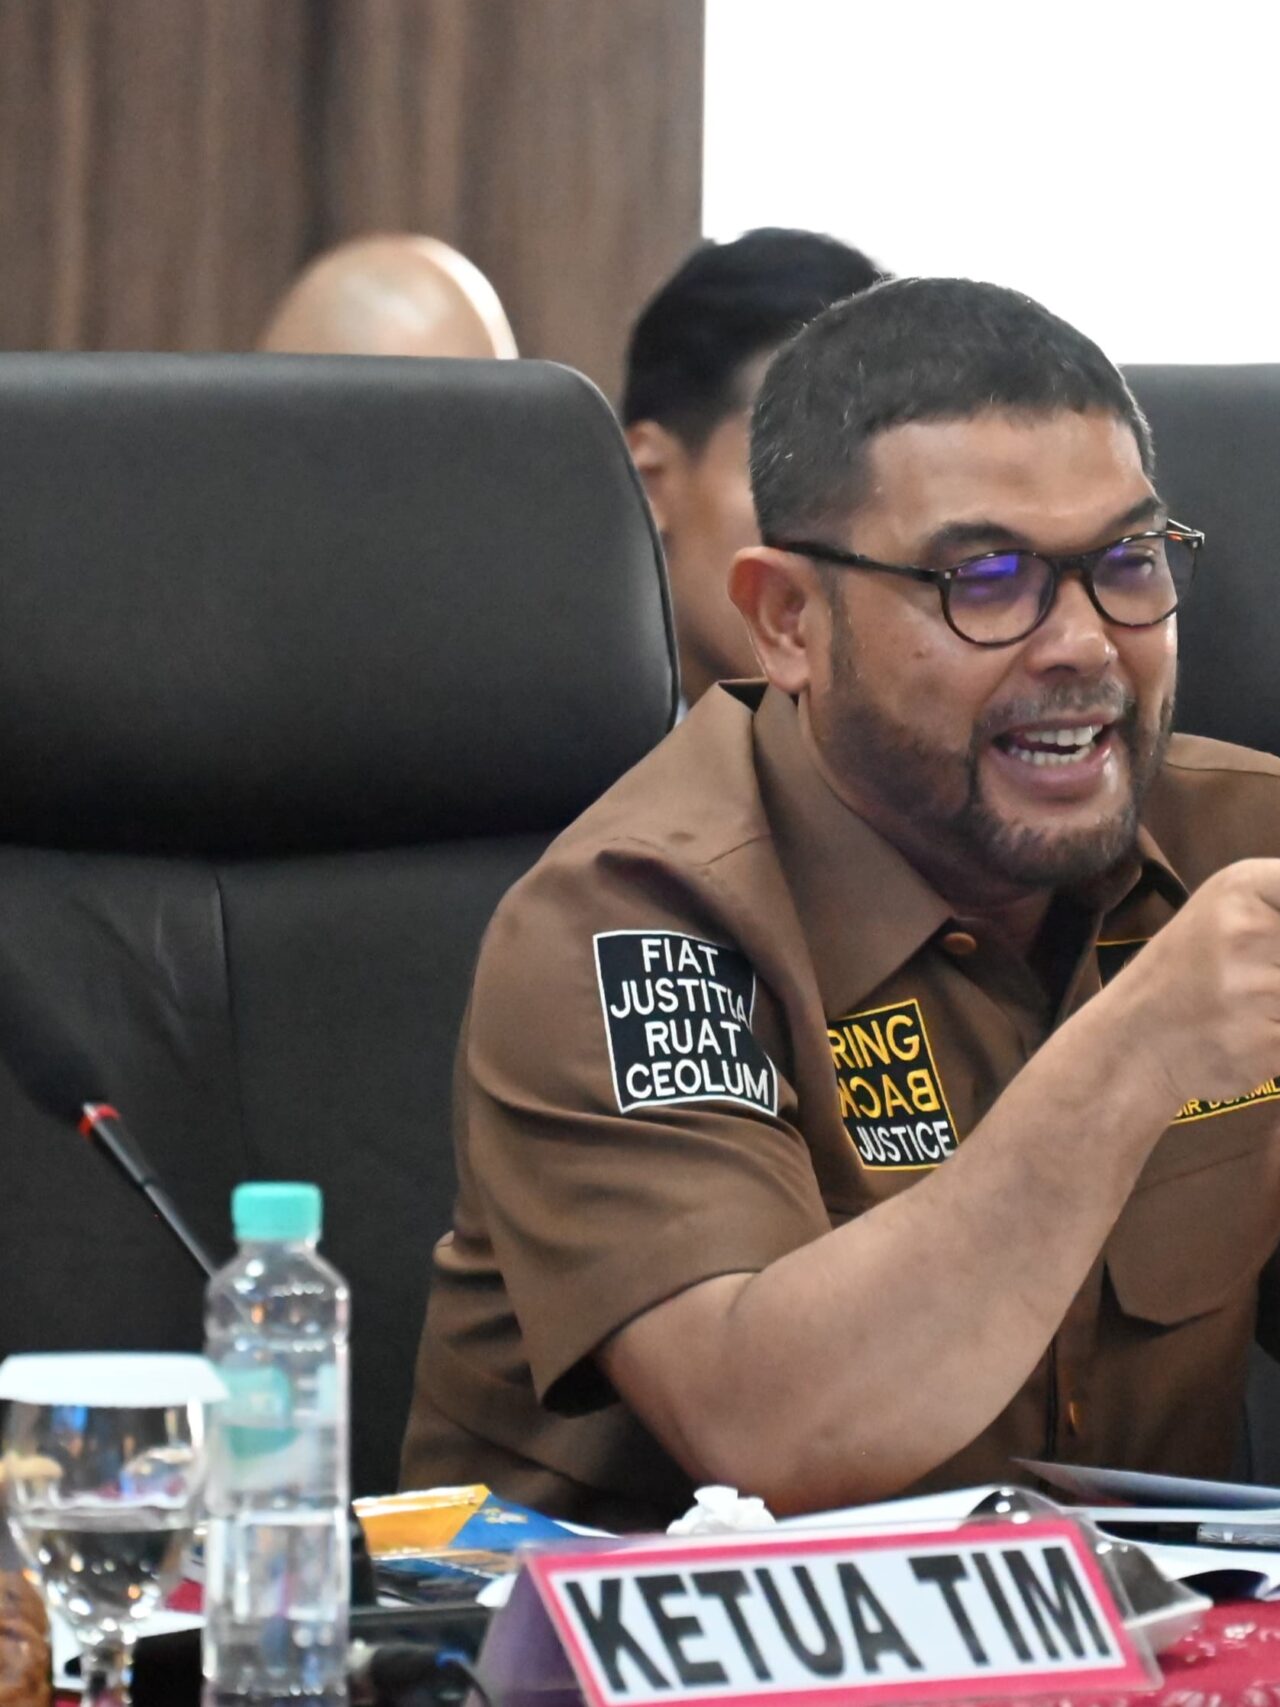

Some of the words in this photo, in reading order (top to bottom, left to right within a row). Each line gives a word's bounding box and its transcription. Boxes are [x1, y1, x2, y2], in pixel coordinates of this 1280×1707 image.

[641, 938, 718, 976] FIAT
[645, 1019, 741, 1057] RUAT
[626, 1061, 769, 1105] CEOLUM
[856, 1121, 955, 1163] JUSTICE
[564, 1560, 925, 1695] KETUA
[908, 1546, 1111, 1667] TIM
